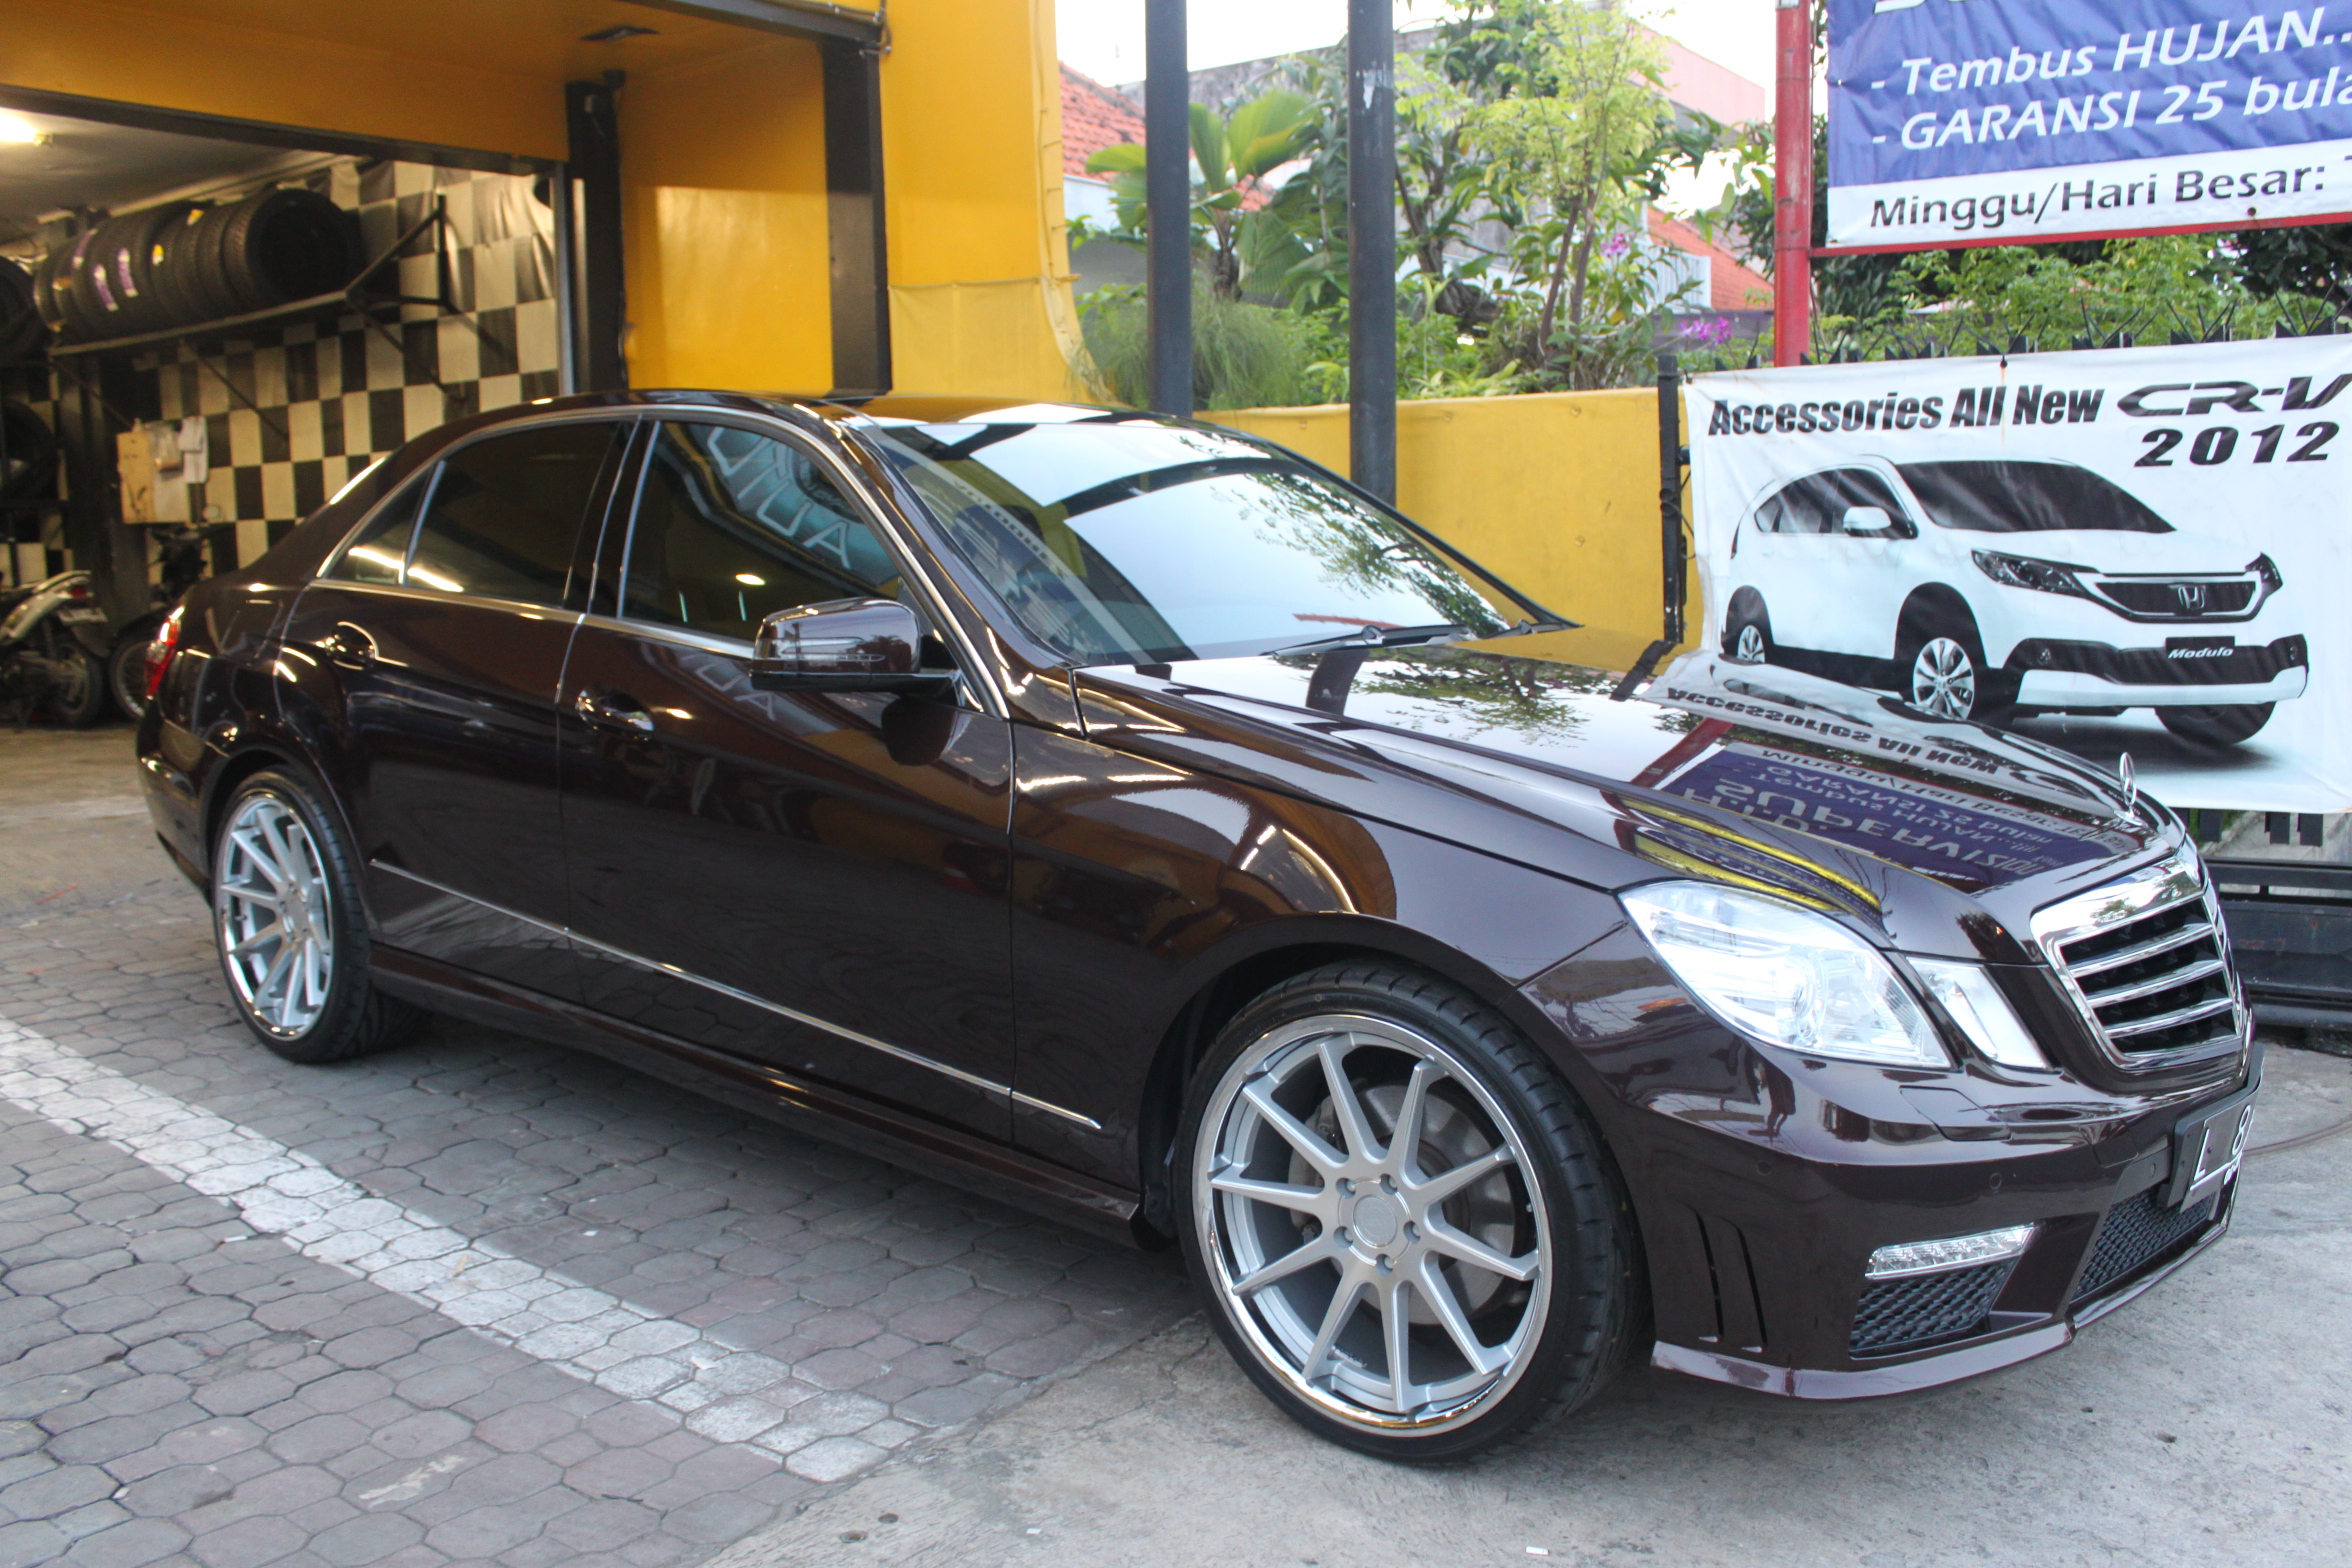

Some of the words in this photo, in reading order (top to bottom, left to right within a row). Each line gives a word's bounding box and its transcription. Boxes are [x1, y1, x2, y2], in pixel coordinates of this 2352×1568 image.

[1901, 46, 2096, 95] Tembus
[1901, 90, 2140, 150] GARANSI
[2155, 81, 2241, 124] 25
[1870, 173, 2157, 231] Minggu/Hari
[2174, 164, 2326, 202] Besar:
[1708, 392, 1941, 436] Accessories
[1949, 384, 2005, 428] All
[2011, 384, 2105, 425] New
[2117, 373, 2352, 417] CR-V
[2133, 421, 2340, 468] 2012
[2167, 646, 2235, 659] Modulo
[2194, 1128, 2210, 1182] L
